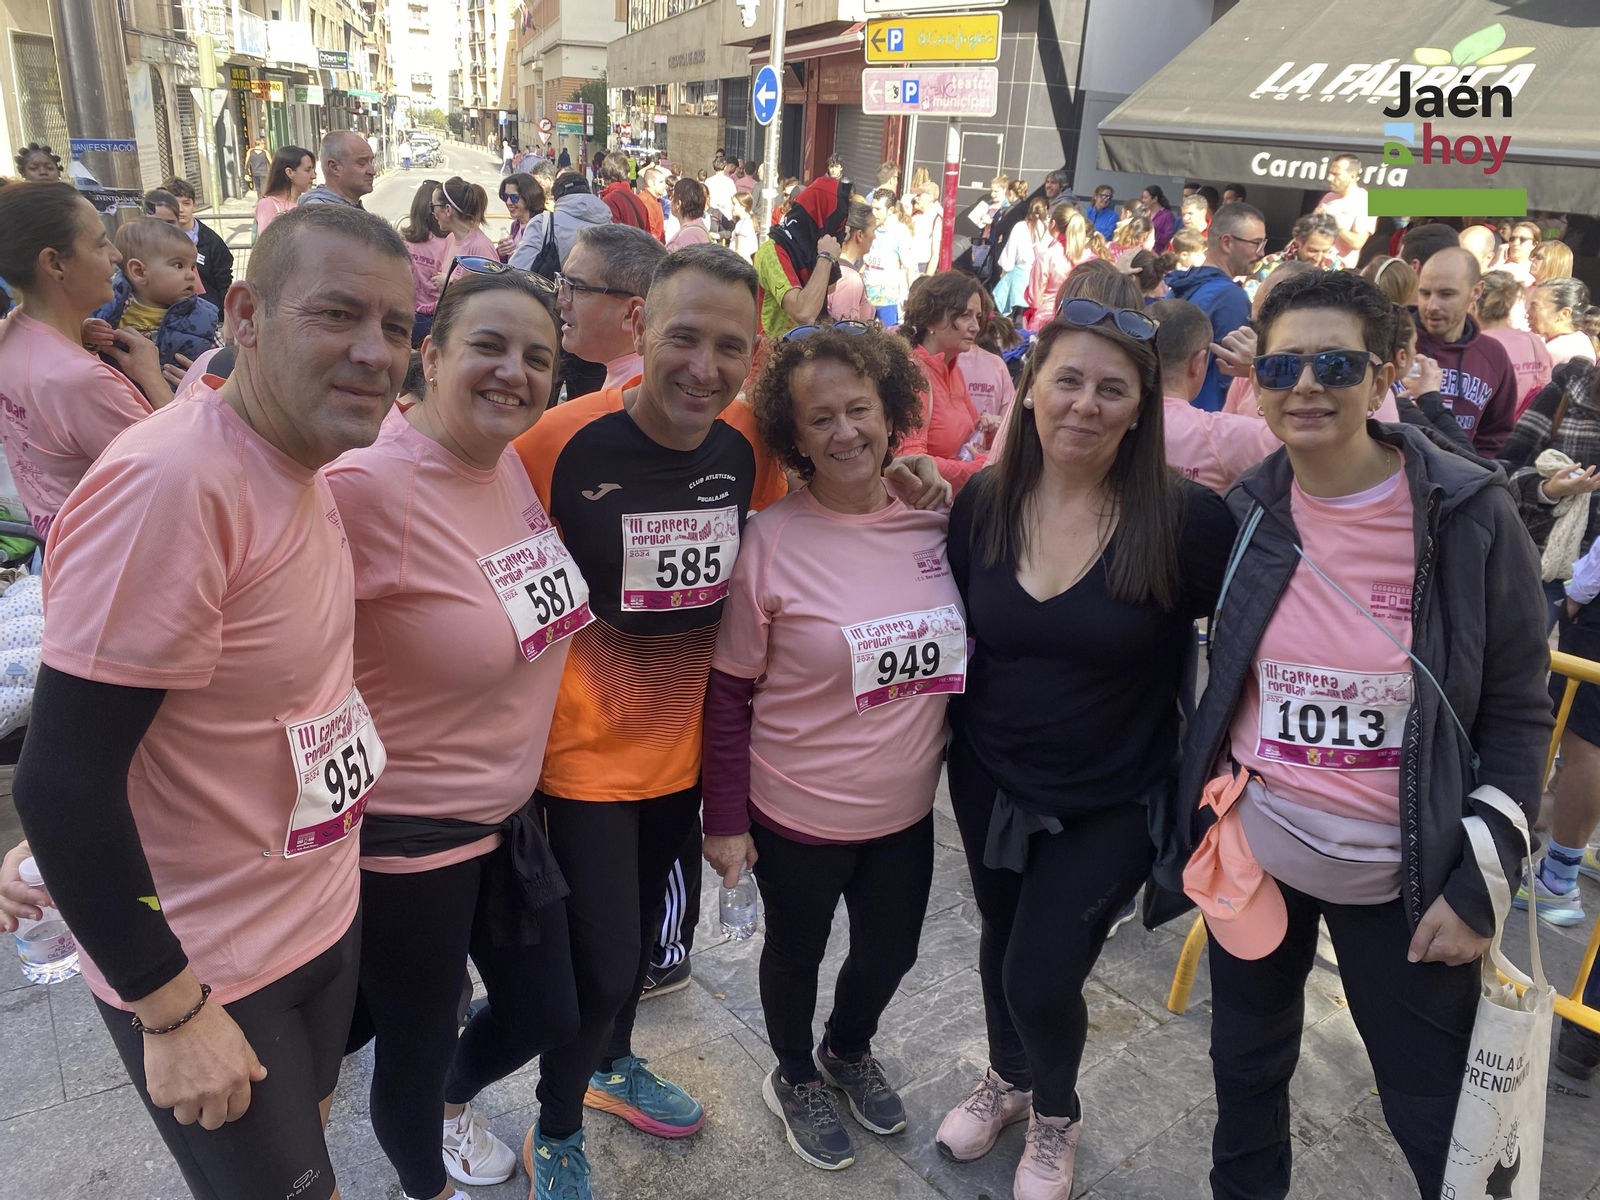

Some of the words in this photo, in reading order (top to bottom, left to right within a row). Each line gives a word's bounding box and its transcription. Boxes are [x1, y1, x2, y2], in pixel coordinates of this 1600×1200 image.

[951, 75, 992, 90] teatro
[1255, 61, 1329, 94] LA
[932, 95, 991, 109] municipal
[71, 143, 136, 152] MANIFESTACIÓN
[1251, 151, 1409, 188] Carniría
[868, 256, 881, 266] 603
[688, 477, 705, 490] CLUB
[705, 473, 737, 482] ATLETISMO
[629, 518, 643, 534] III
[656, 545, 721, 589] 585
[524, 567, 575, 625] 587
[1387, 613, 1403, 621] Juan
[849, 629, 865, 641] III
[877, 641, 940, 685] 949
[1265, 663, 1279, 678] III
[1278, 700, 1385, 748] 1013
[298, 724, 316, 750] III
[324, 736, 375, 814] 951
[1475, 1048, 1515, 1072] AULA
